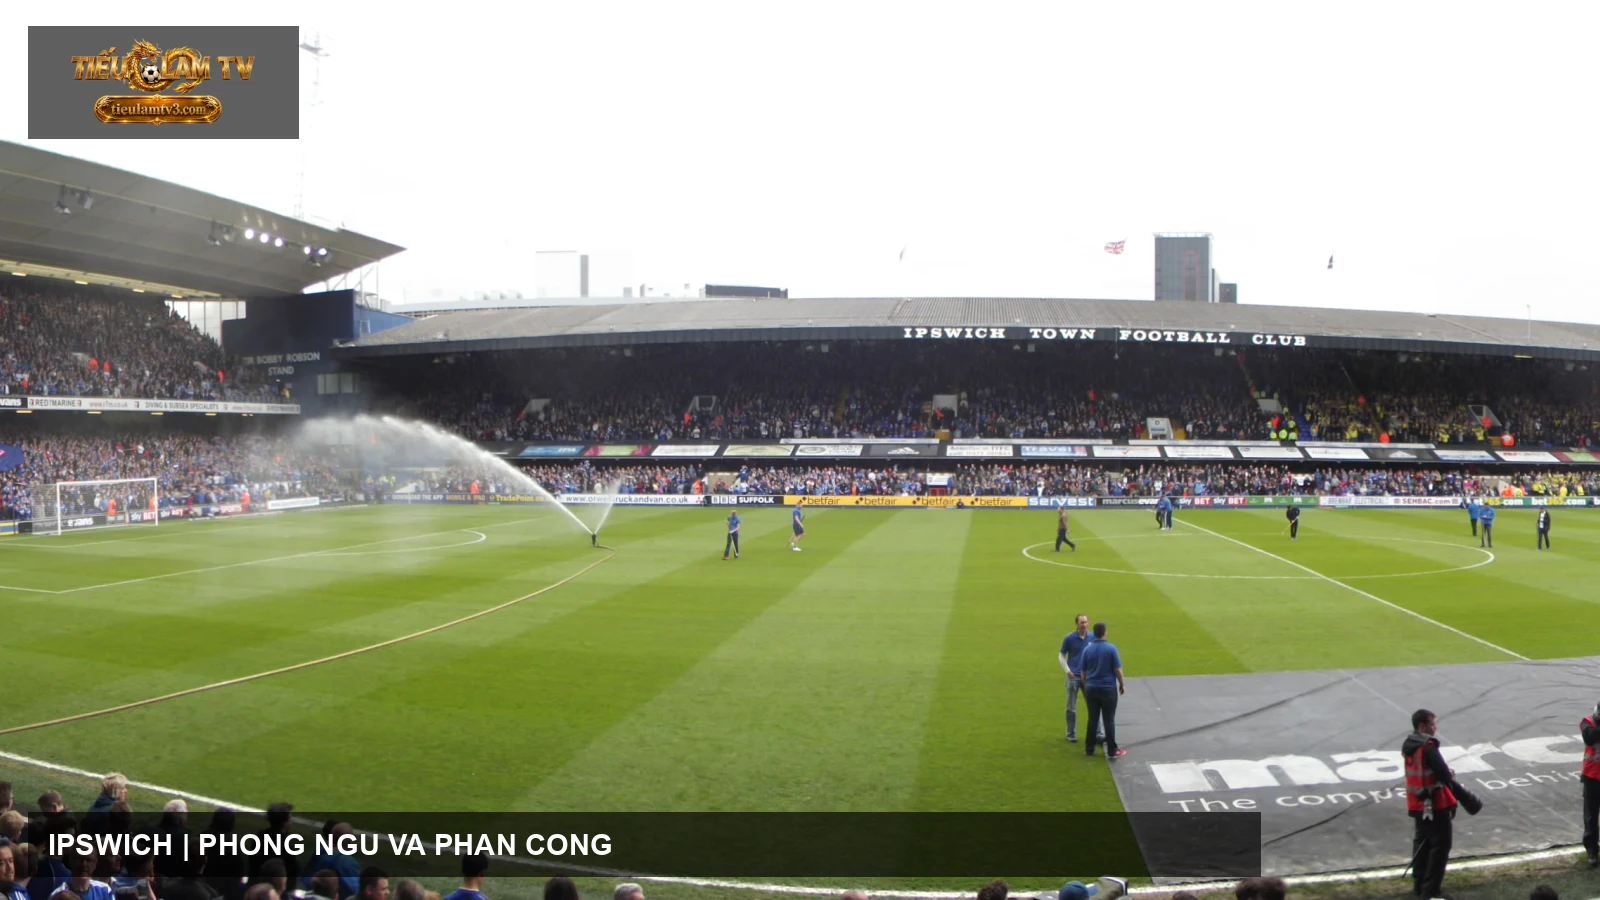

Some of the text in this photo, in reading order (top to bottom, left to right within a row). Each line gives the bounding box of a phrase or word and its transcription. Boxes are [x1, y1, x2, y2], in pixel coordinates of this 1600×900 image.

[903, 328, 1306, 346] IPSWICH TOWN FOOTBALL CLUB
[256, 355, 283, 364] BOBBY
[286, 352, 320, 363] ROBSON
[268, 366, 294, 376] STAND
[711, 496, 774, 504] BBC SUFFOLK
[807, 496, 840, 505] betfair
[864, 497, 897, 506] betfair
[922, 497, 956, 506] betfair
[979, 497, 1013, 506] betfair
[1029, 498, 1095, 506] servest
[1179, 497, 1209, 506] sky BET
[1213, 497, 1226, 506] sky
[1228, 497, 1244, 505] BET
[1531, 496, 1586, 506] bet365.com
[131, 510, 156, 522] sky BET
[160, 508, 183, 518] sky BET
[1150, 734, 1584, 794] marc
[1168, 798, 1257, 813] The
